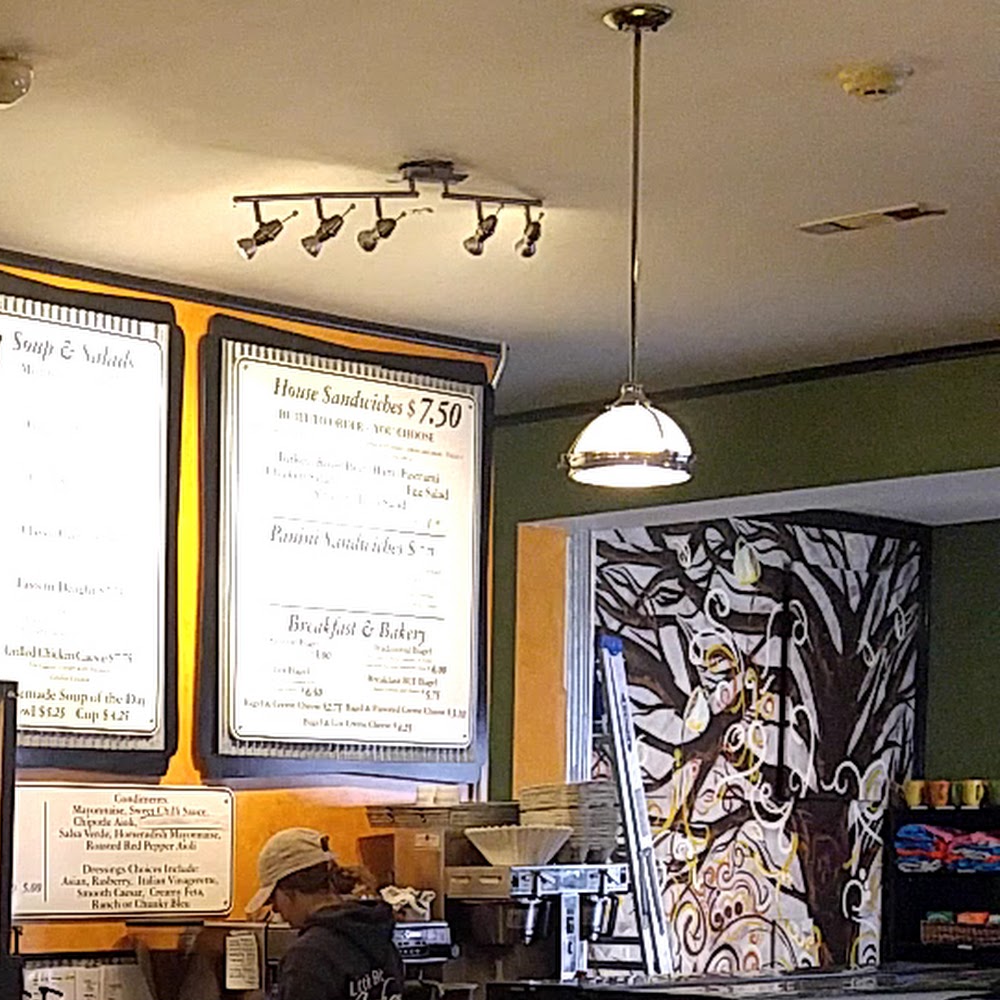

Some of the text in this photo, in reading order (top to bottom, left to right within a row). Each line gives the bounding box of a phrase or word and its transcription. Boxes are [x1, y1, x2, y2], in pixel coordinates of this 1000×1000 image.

[273, 377, 320, 403] House
[322, 384, 403, 417] Sandwiches
[324, 531, 404, 557] Sandwiches
[288, 613, 357, 640] Breakfast
[379, 621, 427, 647] Bakery
[58, 688, 89, 706] Soup
[75, 707, 100, 723] Cup
[59, 828, 83, 839] Salsa
[114, 828, 168, 840] Horseradish
[86, 839, 122, 851] Roasted
[123, 839, 142, 851] Red
[143, 840, 175, 853] Pepper
[138, 875, 166, 886] Italian
[77, 887, 112, 898] Smooth
[91, 899, 121, 910] Ranch
